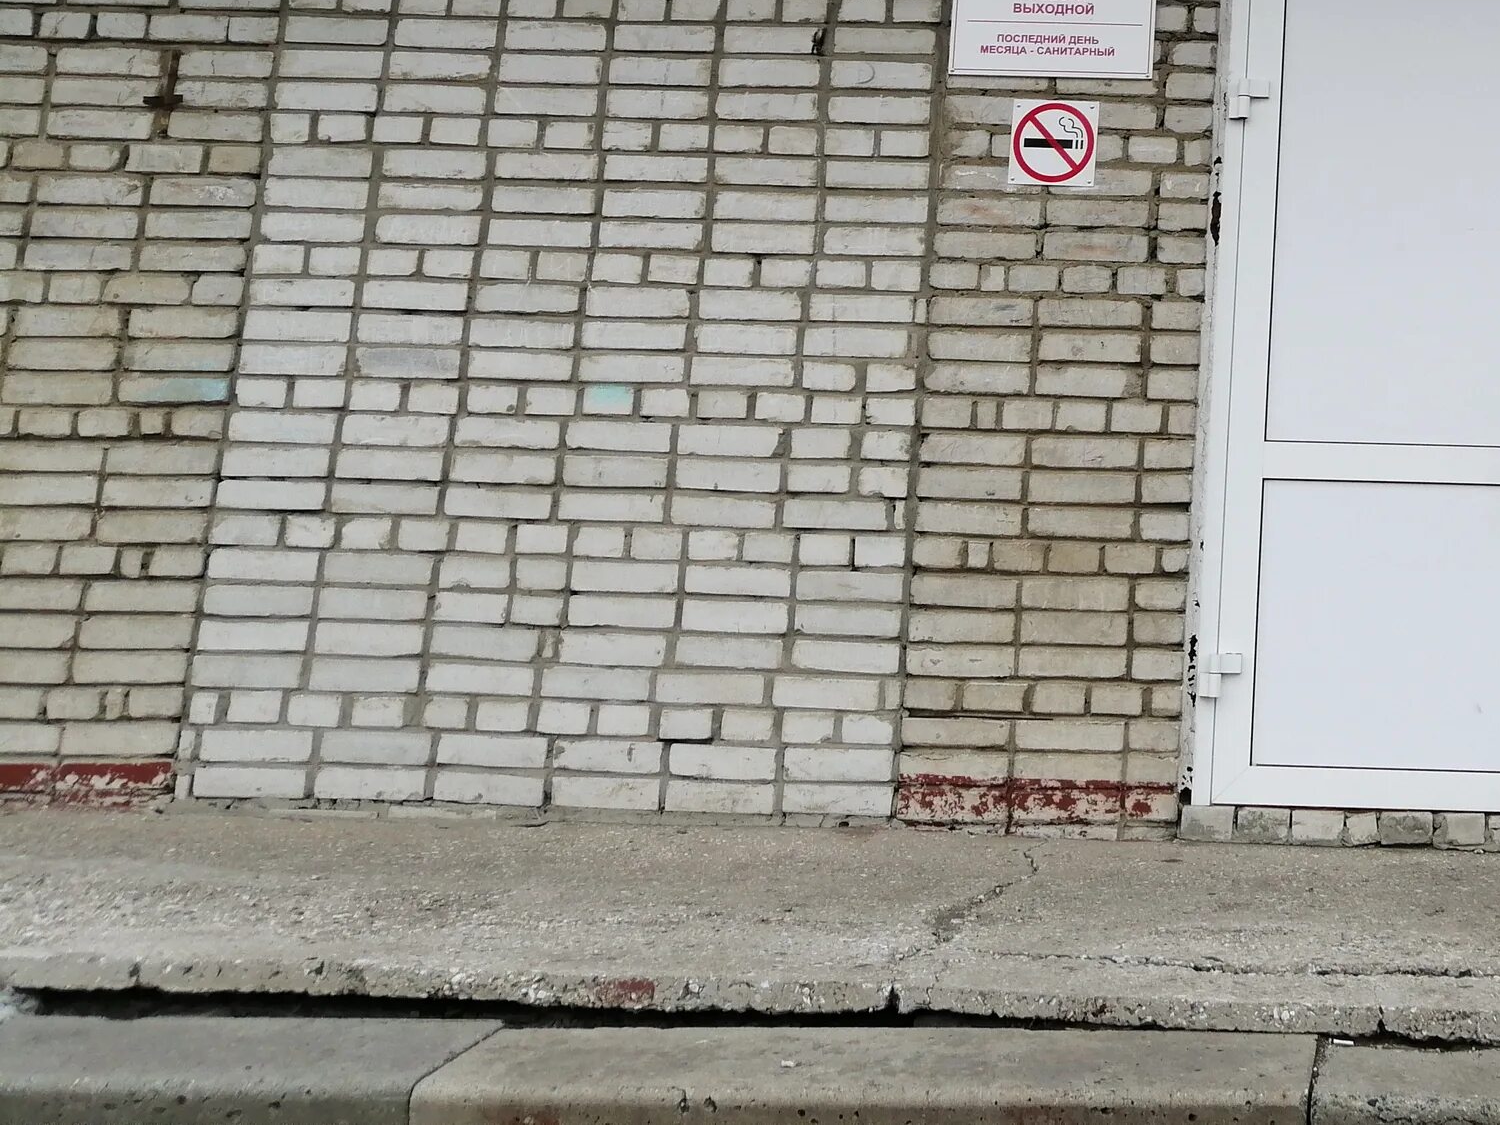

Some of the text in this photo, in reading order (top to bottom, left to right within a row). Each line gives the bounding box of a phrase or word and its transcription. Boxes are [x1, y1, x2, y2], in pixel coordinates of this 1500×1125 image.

[1013, 2, 1095, 16] ВЫХОДНОЙ
[996, 33, 1099, 46] ПОСЛЕДНИЙ ДЕНЬ
[980, 44, 1027, 56] МЕСЯЦА
[1036, 46, 1115, 57] САНИТАРНЫЙ
